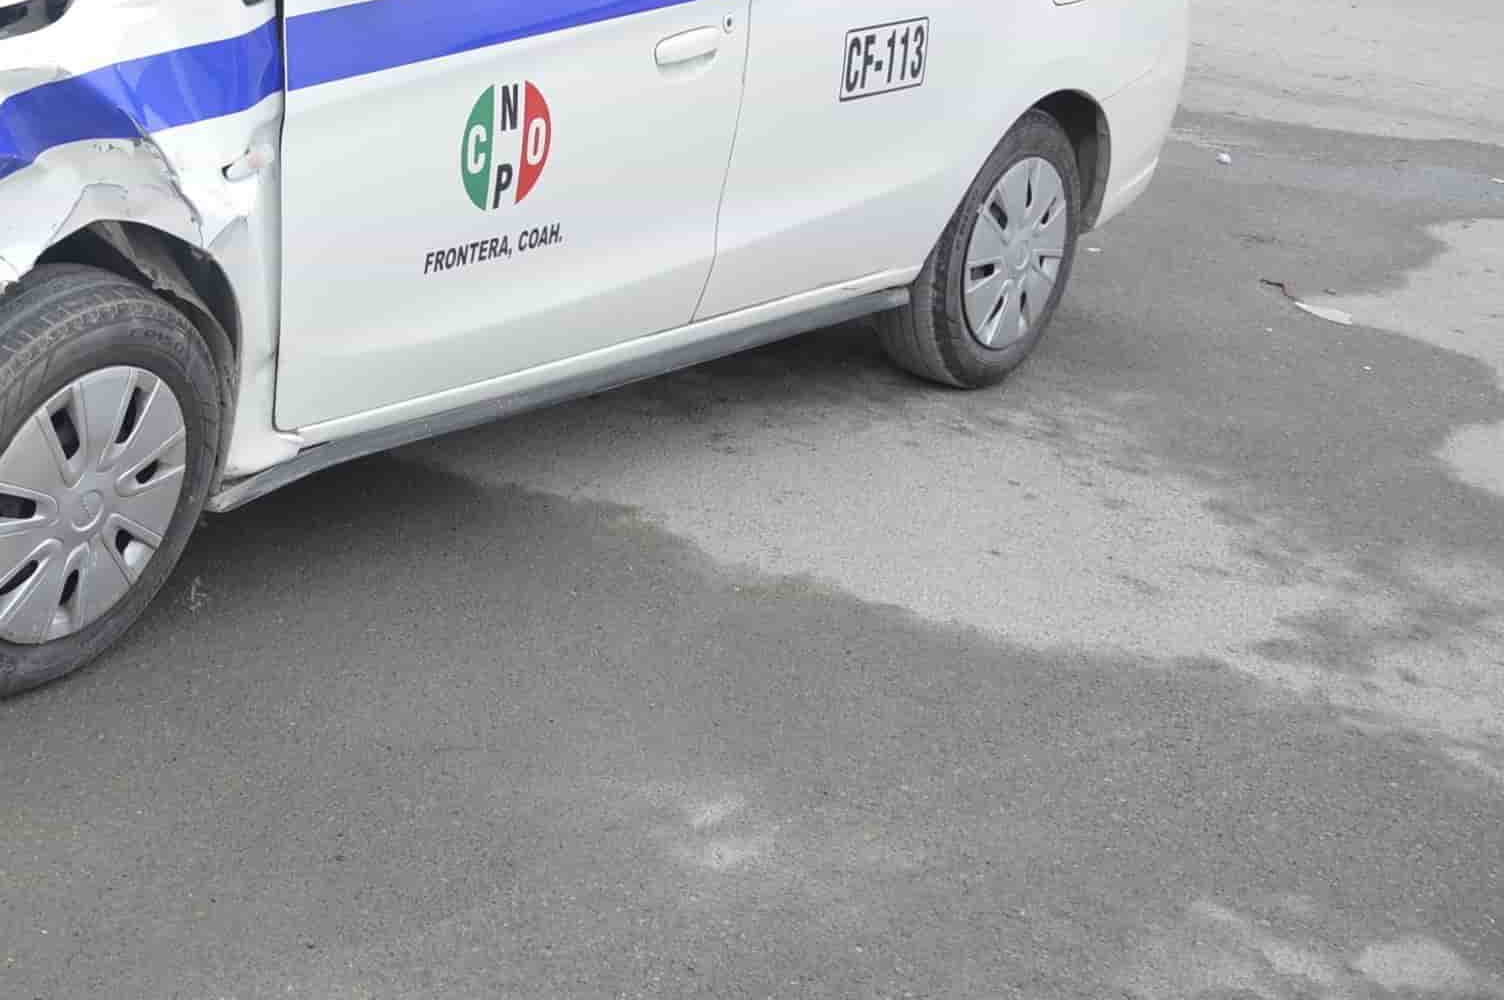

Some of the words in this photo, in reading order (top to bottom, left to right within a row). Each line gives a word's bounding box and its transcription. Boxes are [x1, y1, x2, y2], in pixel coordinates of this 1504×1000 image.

[845, 25, 925, 93] CF-113
[423, 235, 513, 275] FRONTERA,
[518, 222, 563, 253] COAH.
